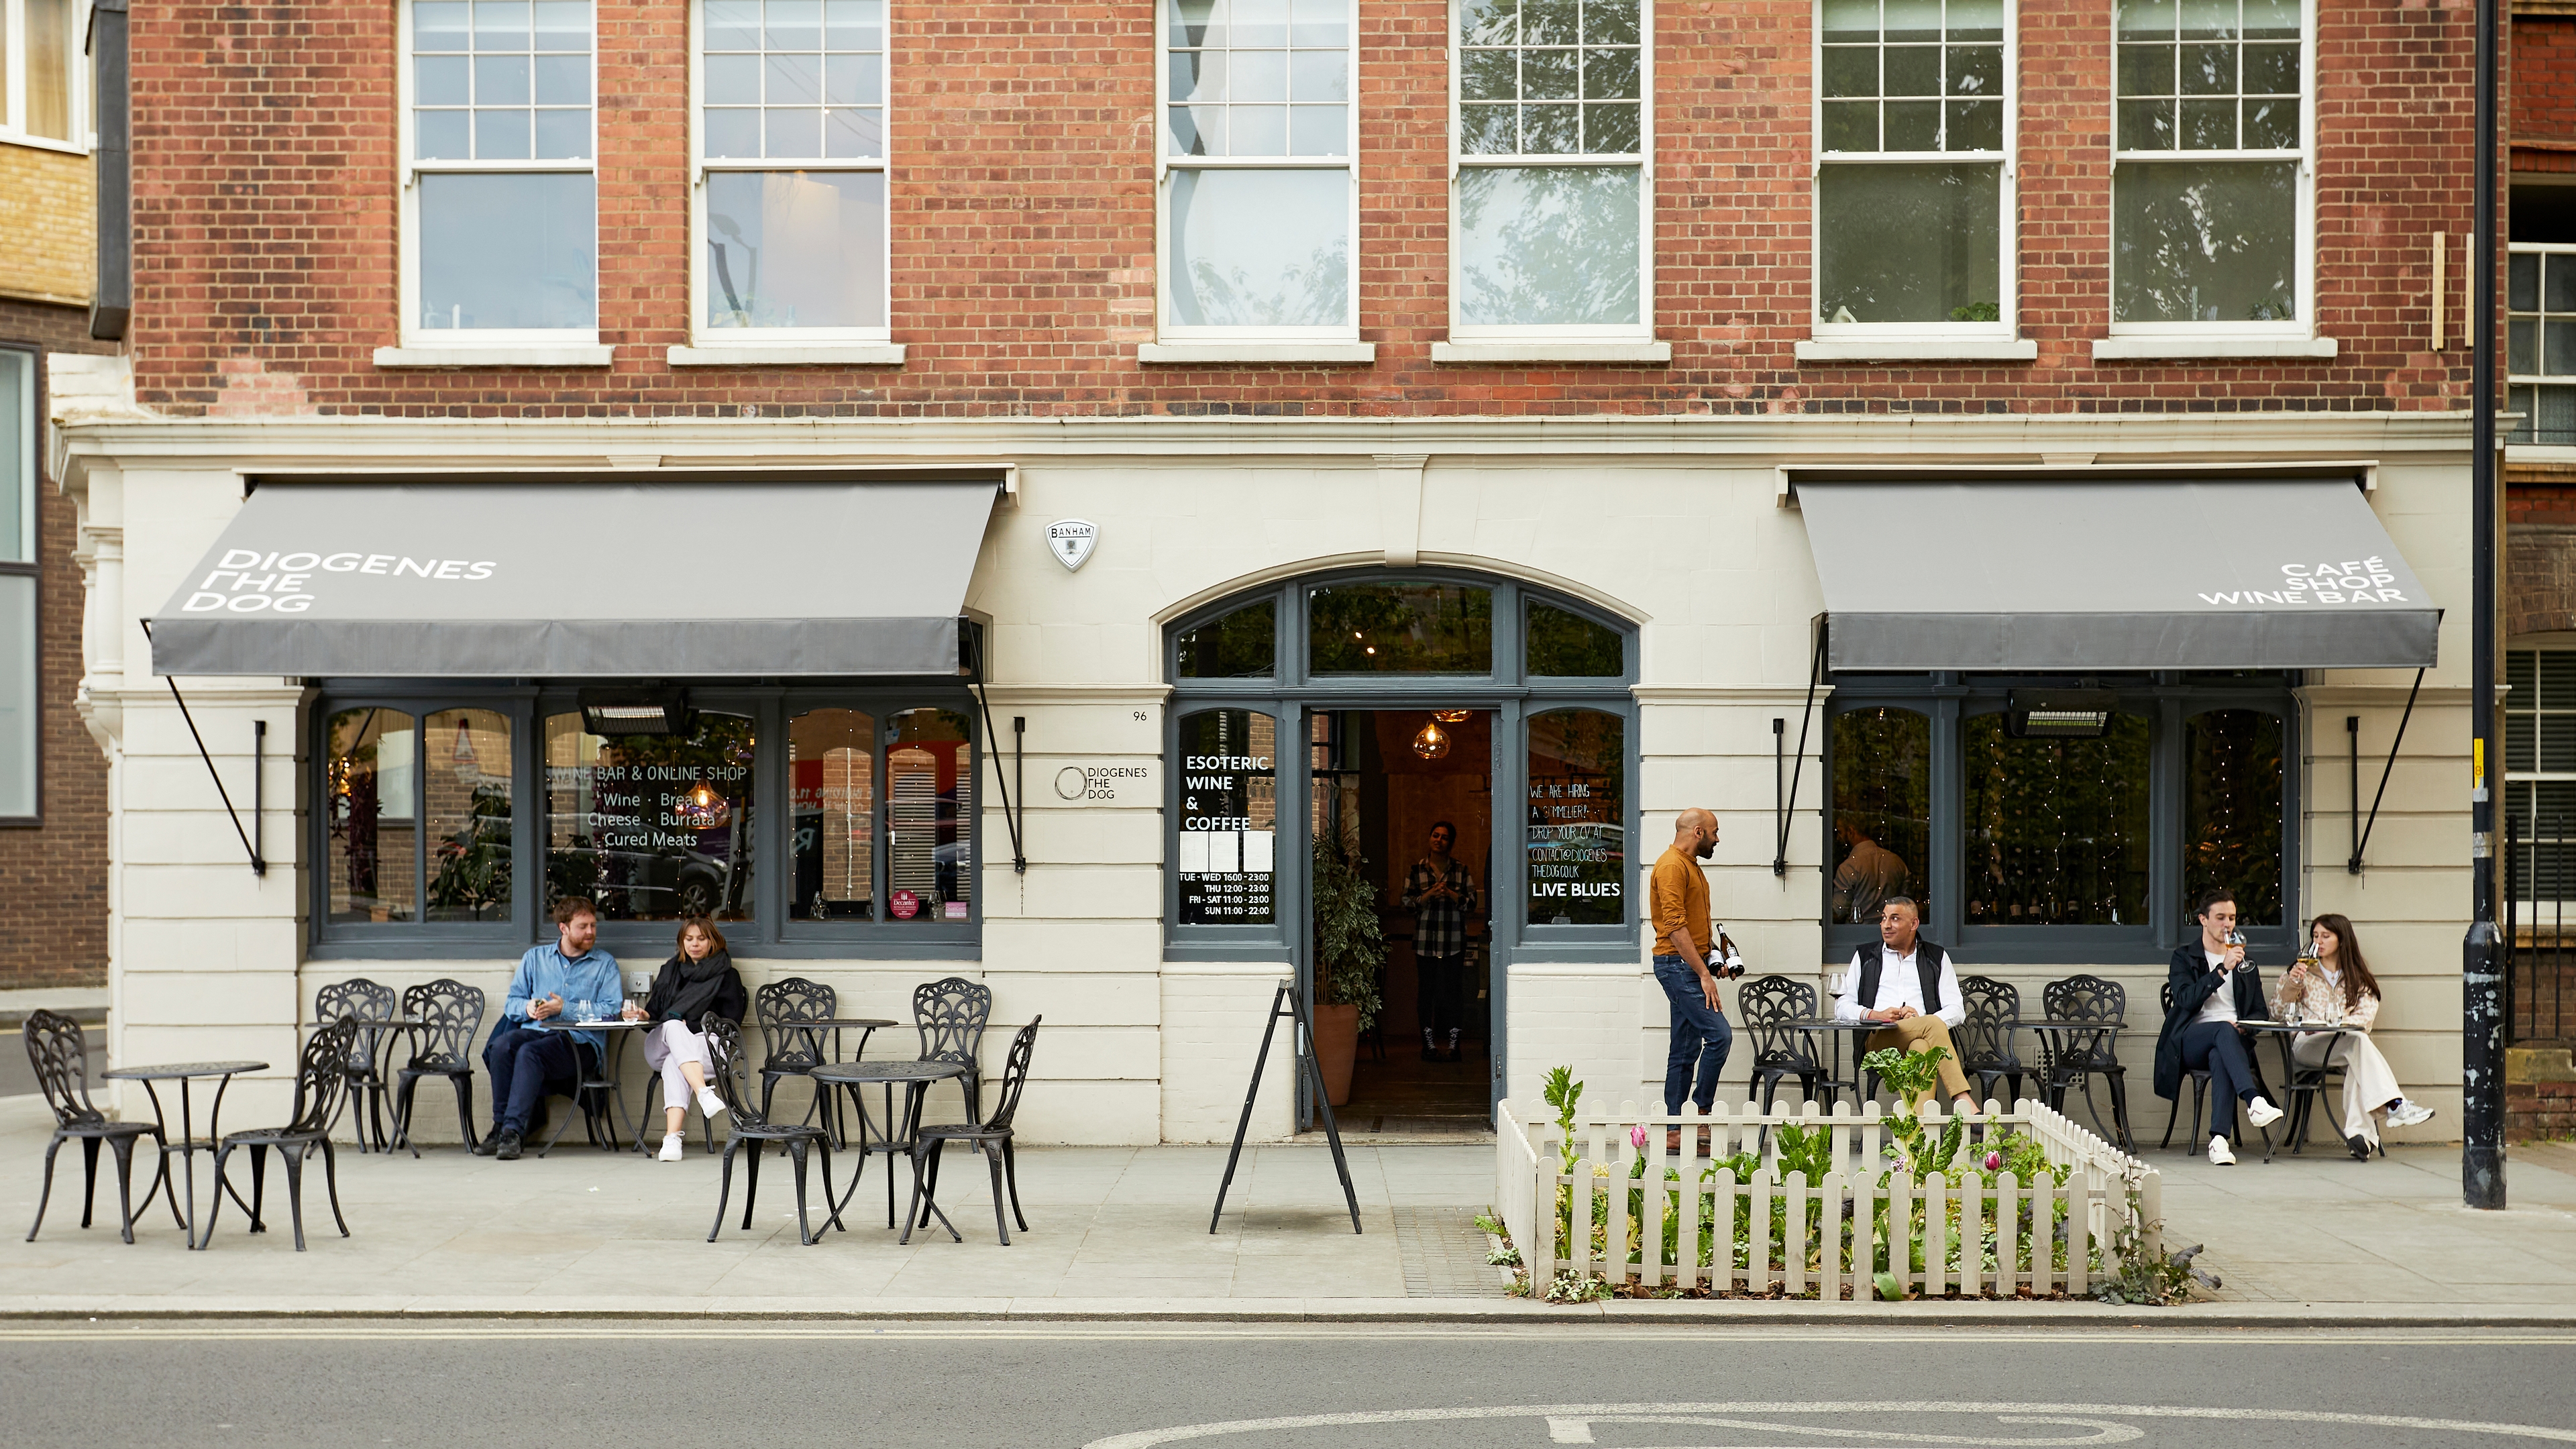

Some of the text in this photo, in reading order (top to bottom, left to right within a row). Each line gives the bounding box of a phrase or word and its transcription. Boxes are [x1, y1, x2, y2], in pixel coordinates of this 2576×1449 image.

[1051, 527, 1091, 538] BANHAM
[217, 548, 497, 580] DIOGENES
[2281, 555, 2390, 577] CAFÉ
[2286, 574, 2395, 591] SHOP
[181, 592, 315, 612] DOG
[2198, 588, 2408, 605] WINE BAR
[1133, 711, 1147, 721] 96
[1186, 755, 1269, 770] ESOTERIC
[552, 765, 592, 780] WINE
[597, 765, 625, 780] BAR
[631, 765, 642, 780] &
[647, 765, 701, 780] ONLINE
[707, 765, 747, 780] SHOP
[1088, 767, 1147, 777] DIOGENES
[1185, 776, 1233, 790] WINE
[1088, 790, 1115, 800] DOG
[1529, 784, 1590, 798] WE ARE HIRING
[604, 792, 640, 806] Wine
[1185, 796, 1199, 810] &
[588, 812, 715, 826] Cheese Burrata
[1532, 806, 1539, 818] A
[1185, 816, 1251, 830] COFFEE
[604, 832, 697, 847] Cured Meats
[1532, 826, 1604, 839] DROP YOUR CV AT
[1532, 847, 1607, 863] CONTACT@DIOGENES
[1179, 873, 1196, 881] TUE
[1201, 873, 1222, 881] WED
[1204, 884, 1221, 893] THU
[1223, 884, 1243, 893] 12:00
[1248, 884, 1269, 893] 23:00
[1532, 882, 1621, 897] LIVE BLUES
[1189, 896, 1201, 904] FRI
[1207, 896, 1222, 904] SAT
[1223, 896, 1243, 904] 11:00
[1248, 896, 1269, 904] 23:00
[1205, 906, 1221, 915] SUN
[1223, 906, 1243, 915] 11:00
[1248, 906, 1269, 915] 22:00
